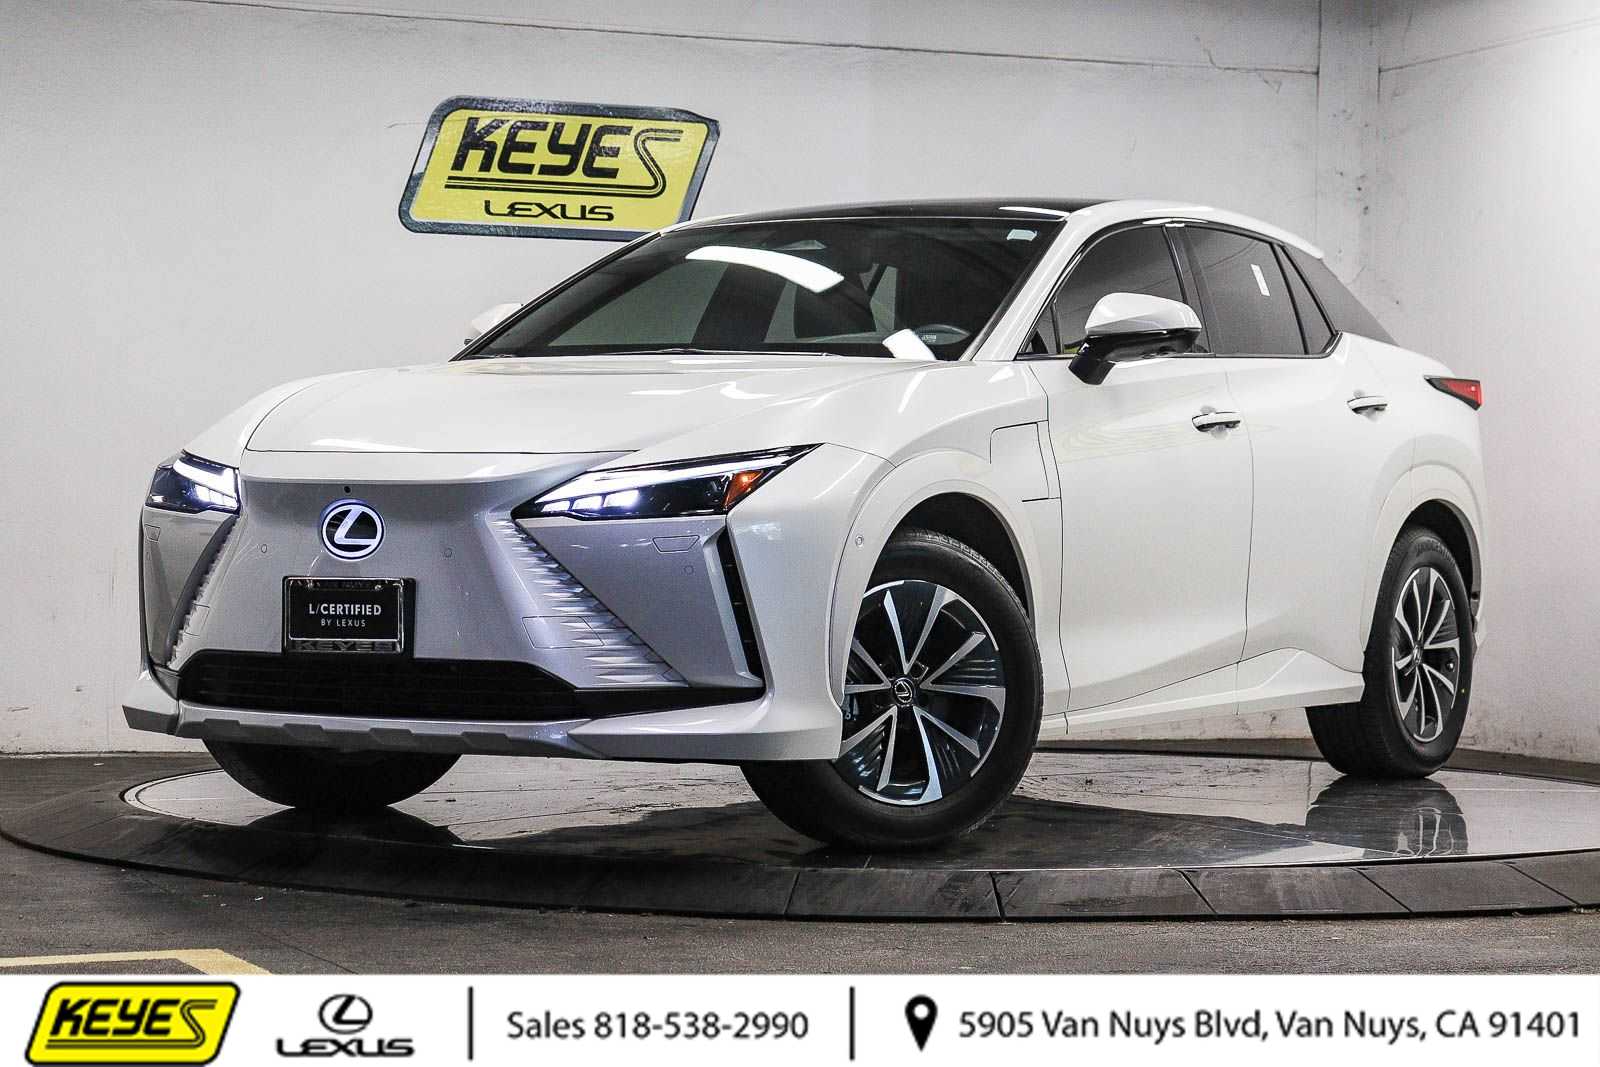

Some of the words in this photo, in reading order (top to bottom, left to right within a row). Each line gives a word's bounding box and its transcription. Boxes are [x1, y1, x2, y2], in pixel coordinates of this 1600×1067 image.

[448, 116, 684, 197] KEYES
[484, 199, 614, 221] LEXUS
[308, 602, 382, 616] L/CERTIFIED
[320, 618, 331, 627] BY
[336, 618, 366, 628] LEXUS
